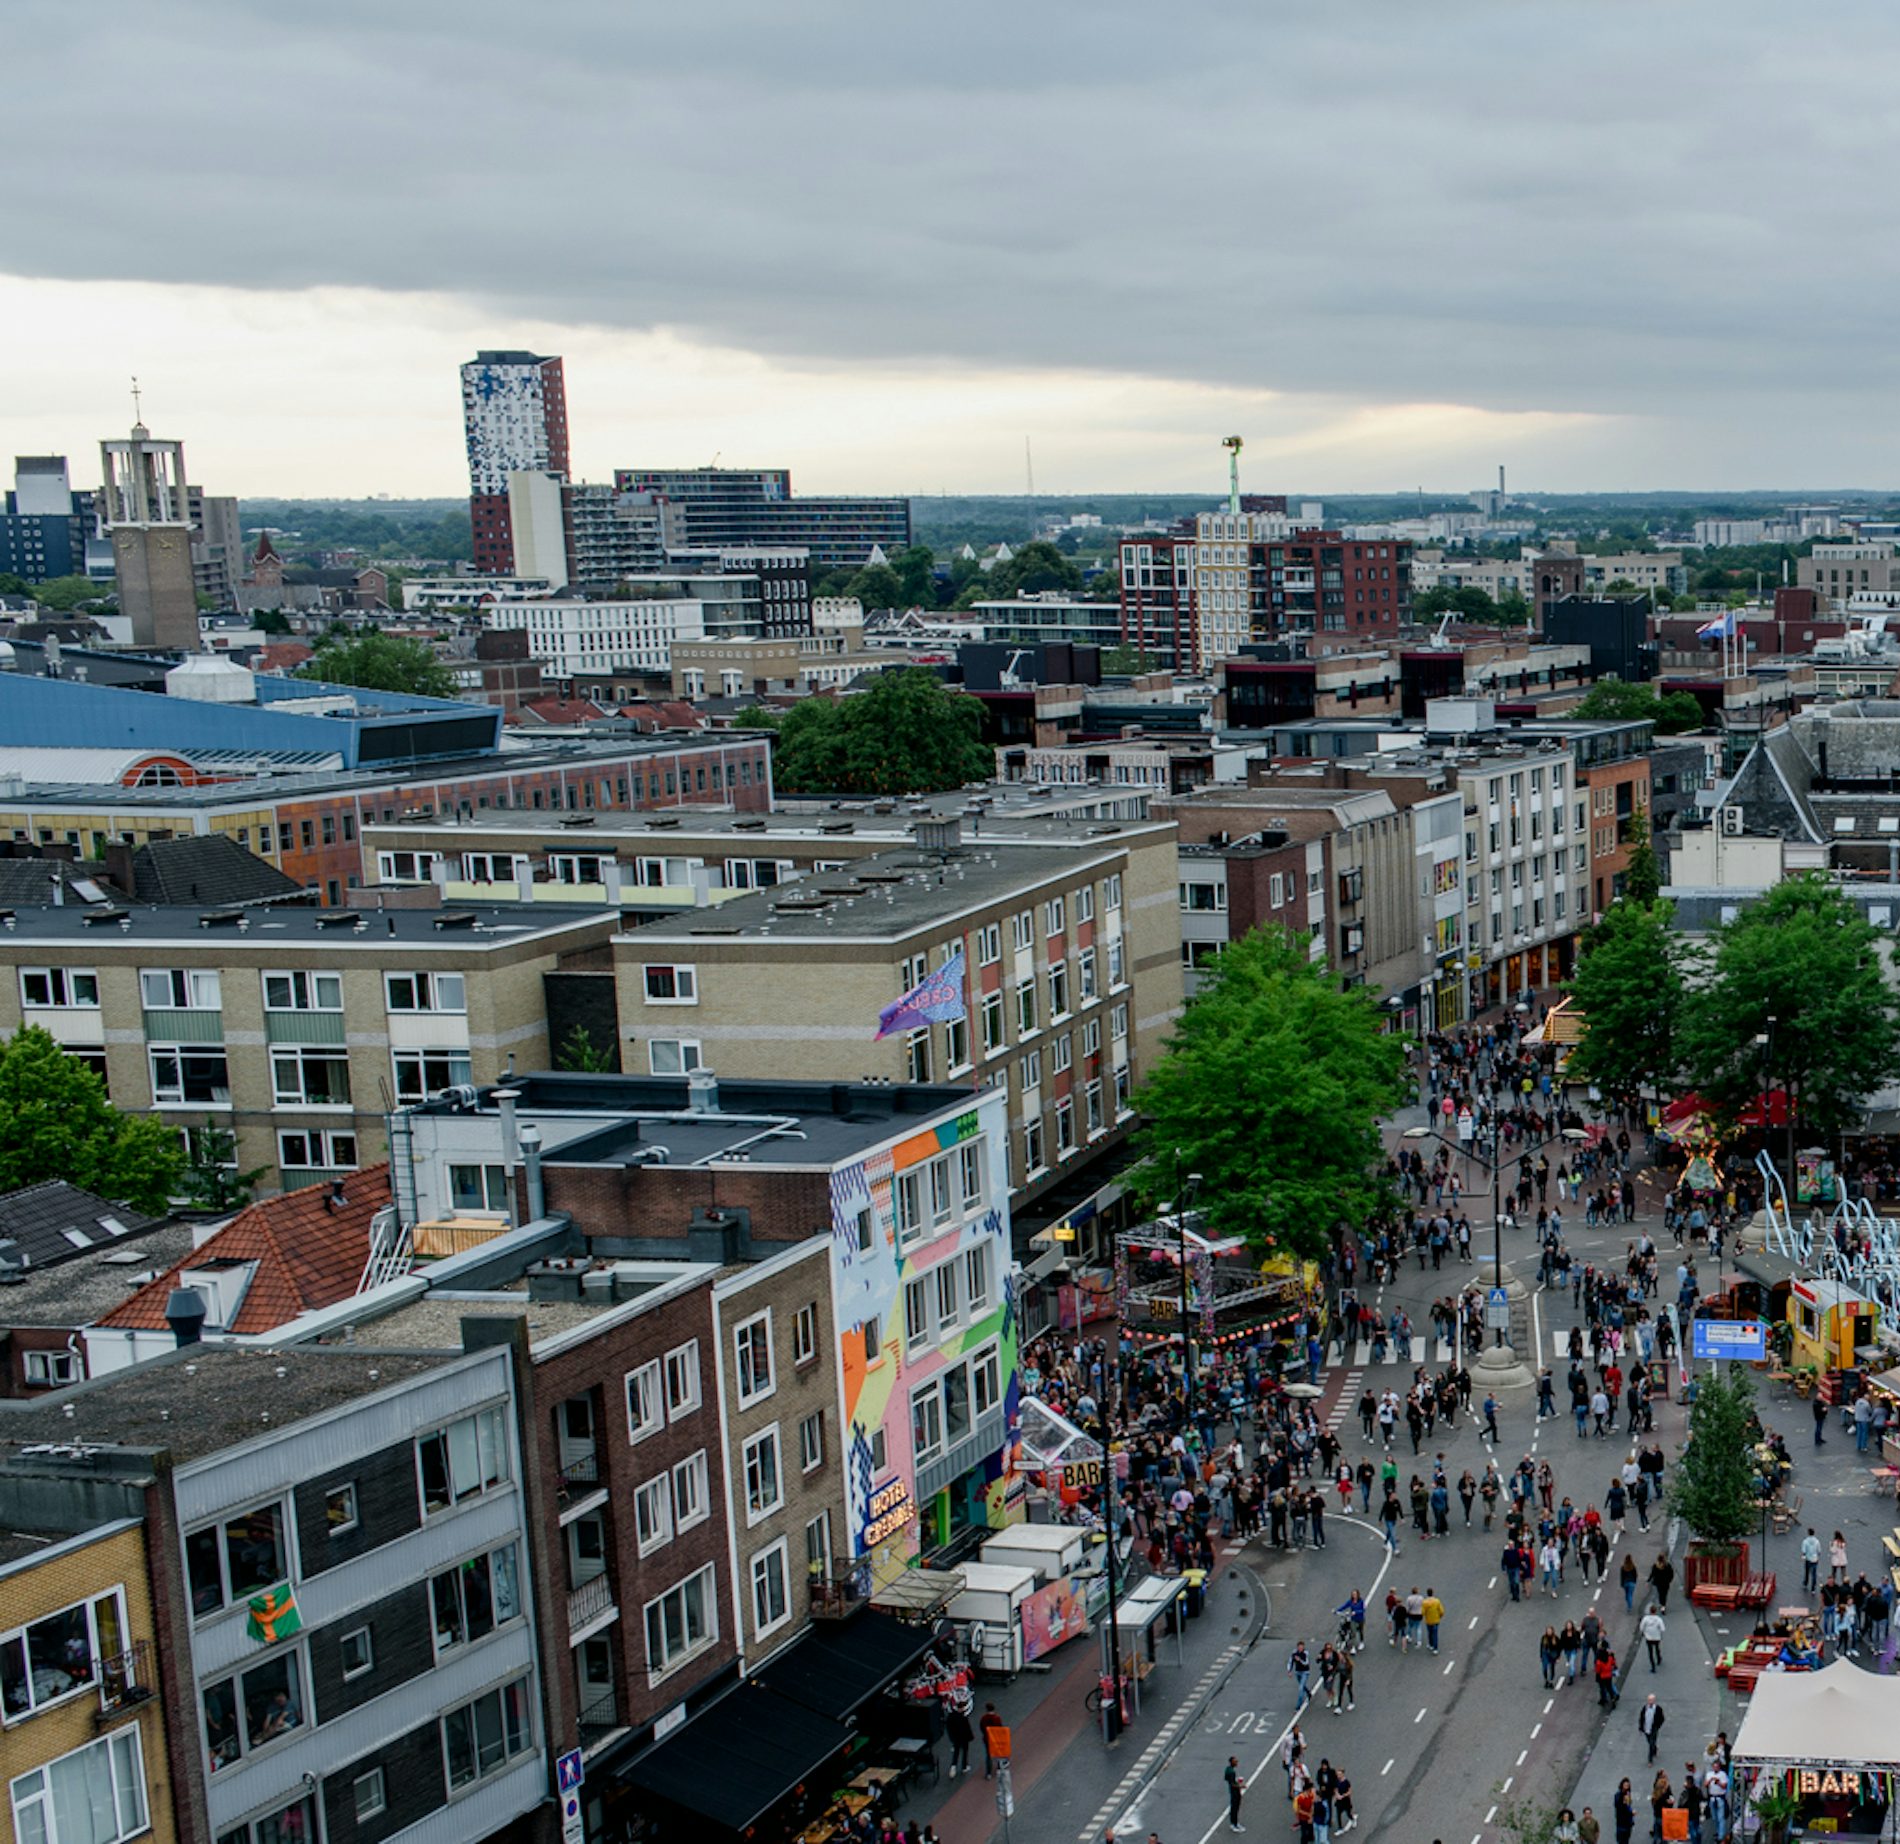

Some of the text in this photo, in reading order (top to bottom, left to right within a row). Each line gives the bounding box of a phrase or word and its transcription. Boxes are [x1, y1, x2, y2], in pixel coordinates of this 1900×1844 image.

[1064, 1462, 1100, 1488] BAR
[870, 1481, 907, 1519] HOTEL
[1205, 1711, 1276, 1734] BUS
[1800, 1770, 1859, 1794] BAR
